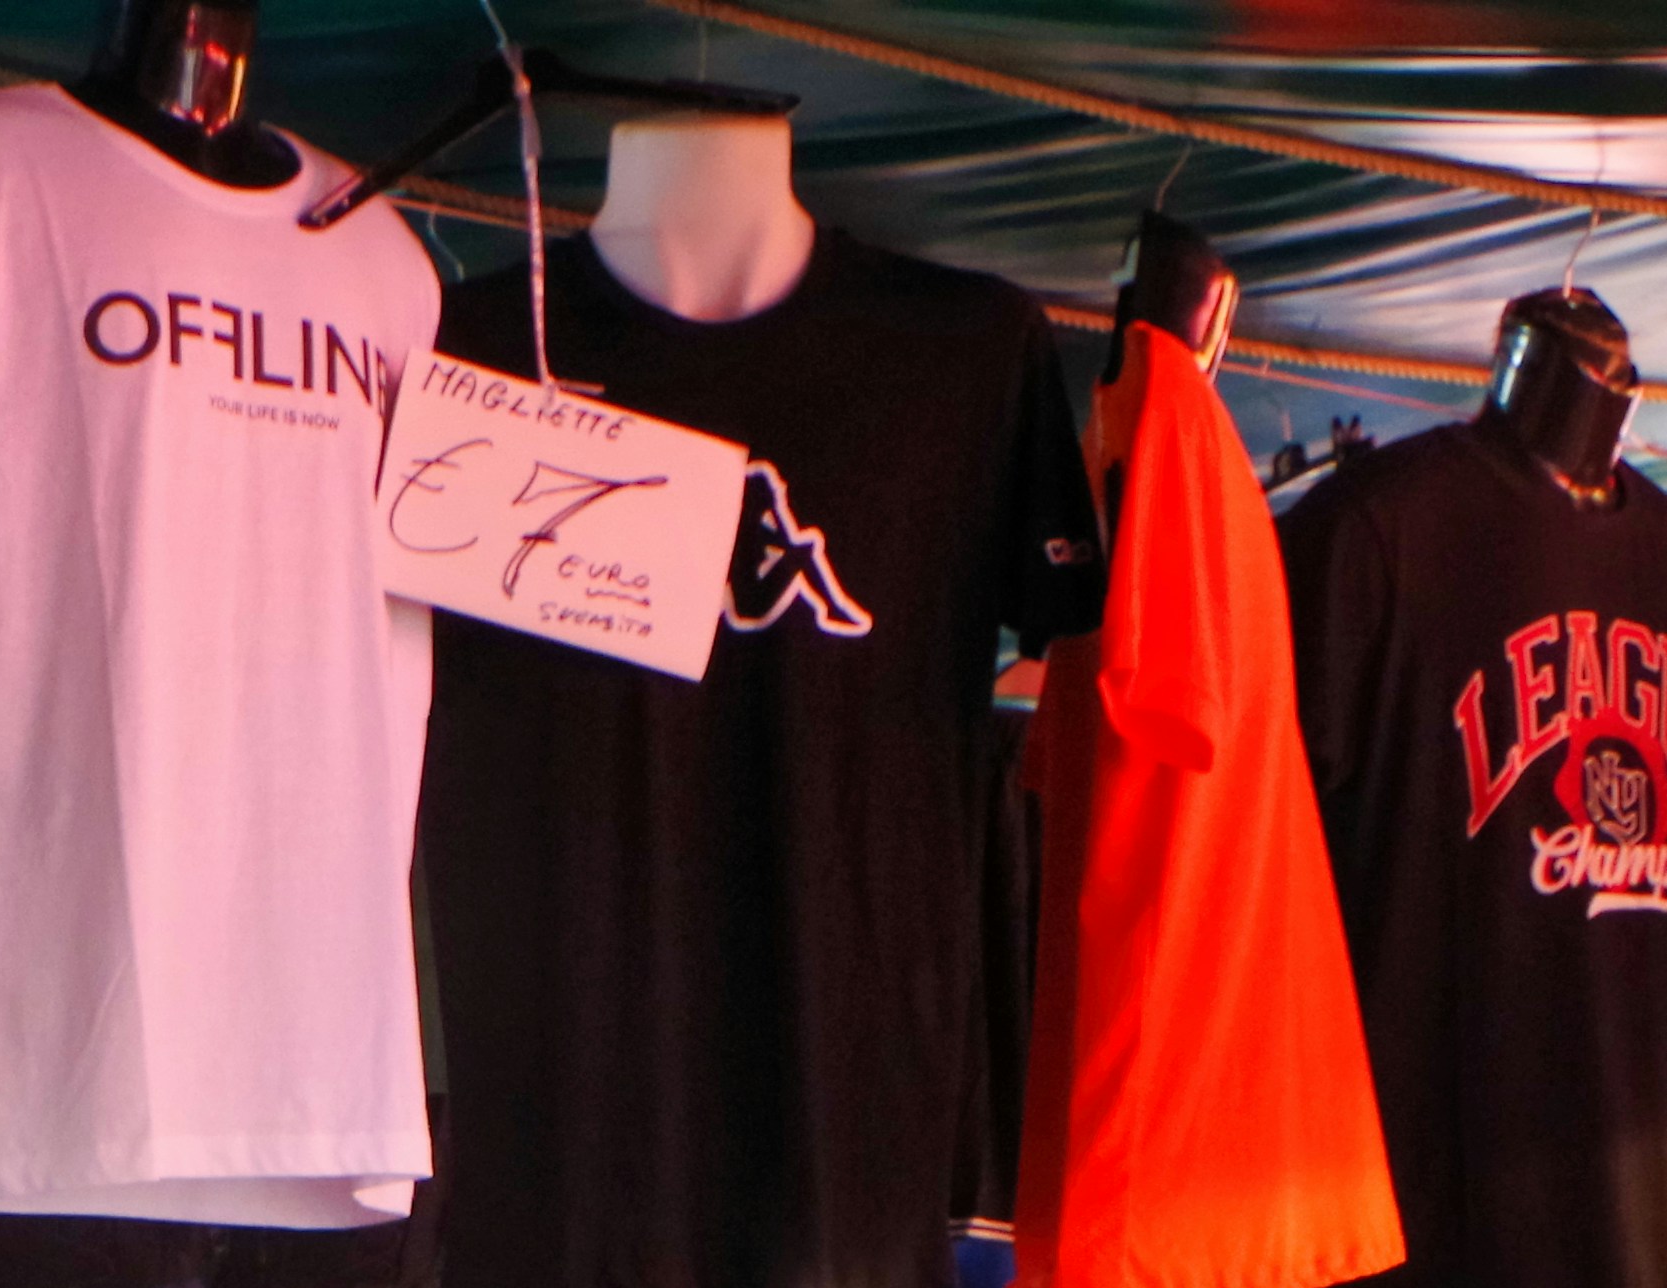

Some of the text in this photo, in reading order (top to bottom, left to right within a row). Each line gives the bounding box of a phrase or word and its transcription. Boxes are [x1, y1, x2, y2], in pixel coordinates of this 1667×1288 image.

[209, 394, 341, 432] YOUR LIFE IS NOW
[422, 361, 636, 441] MAGLIETTE
[1453, 610, 1667, 840] LEAG
